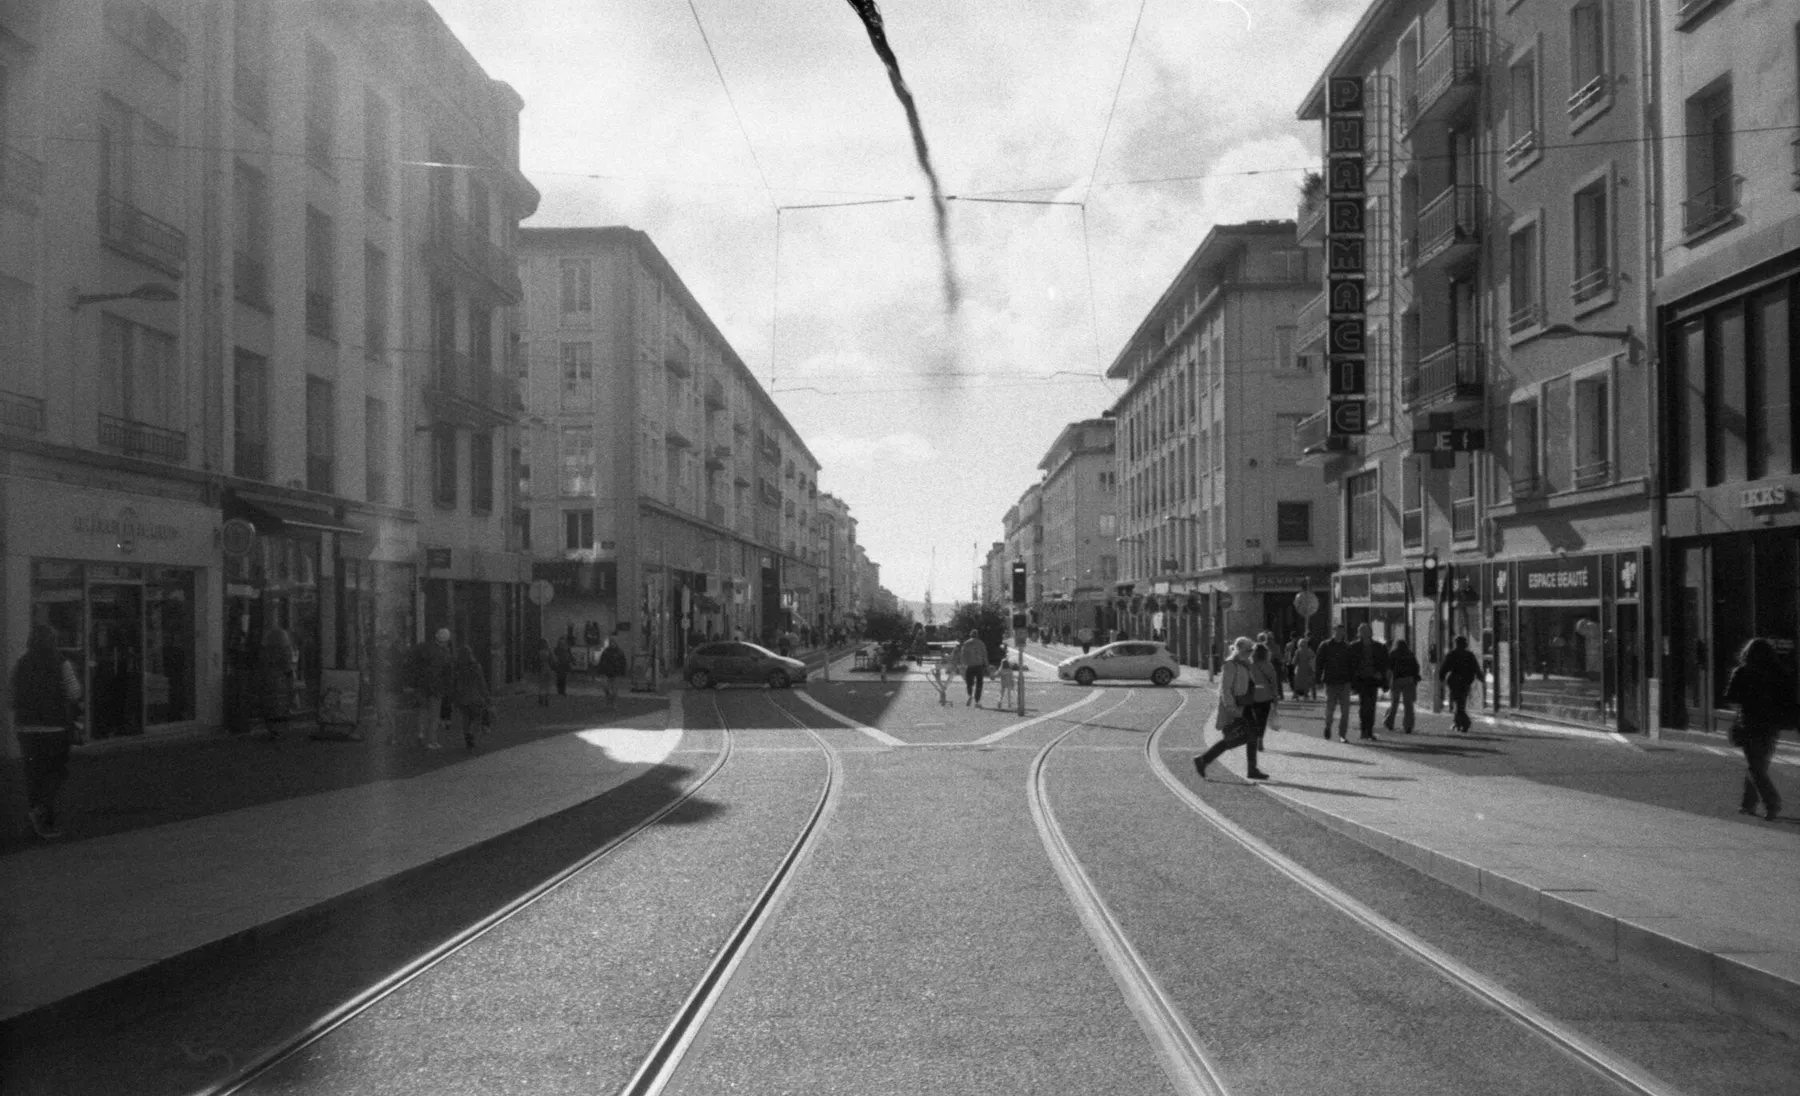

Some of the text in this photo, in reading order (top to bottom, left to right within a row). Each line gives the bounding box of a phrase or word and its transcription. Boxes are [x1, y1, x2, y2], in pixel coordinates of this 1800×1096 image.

[1330, 79, 1363, 434] PHARMACIE
[1740, 484, 1786, 508] IKKS
[1528, 565, 1589, 589] ESPACE BEAUTÉ
